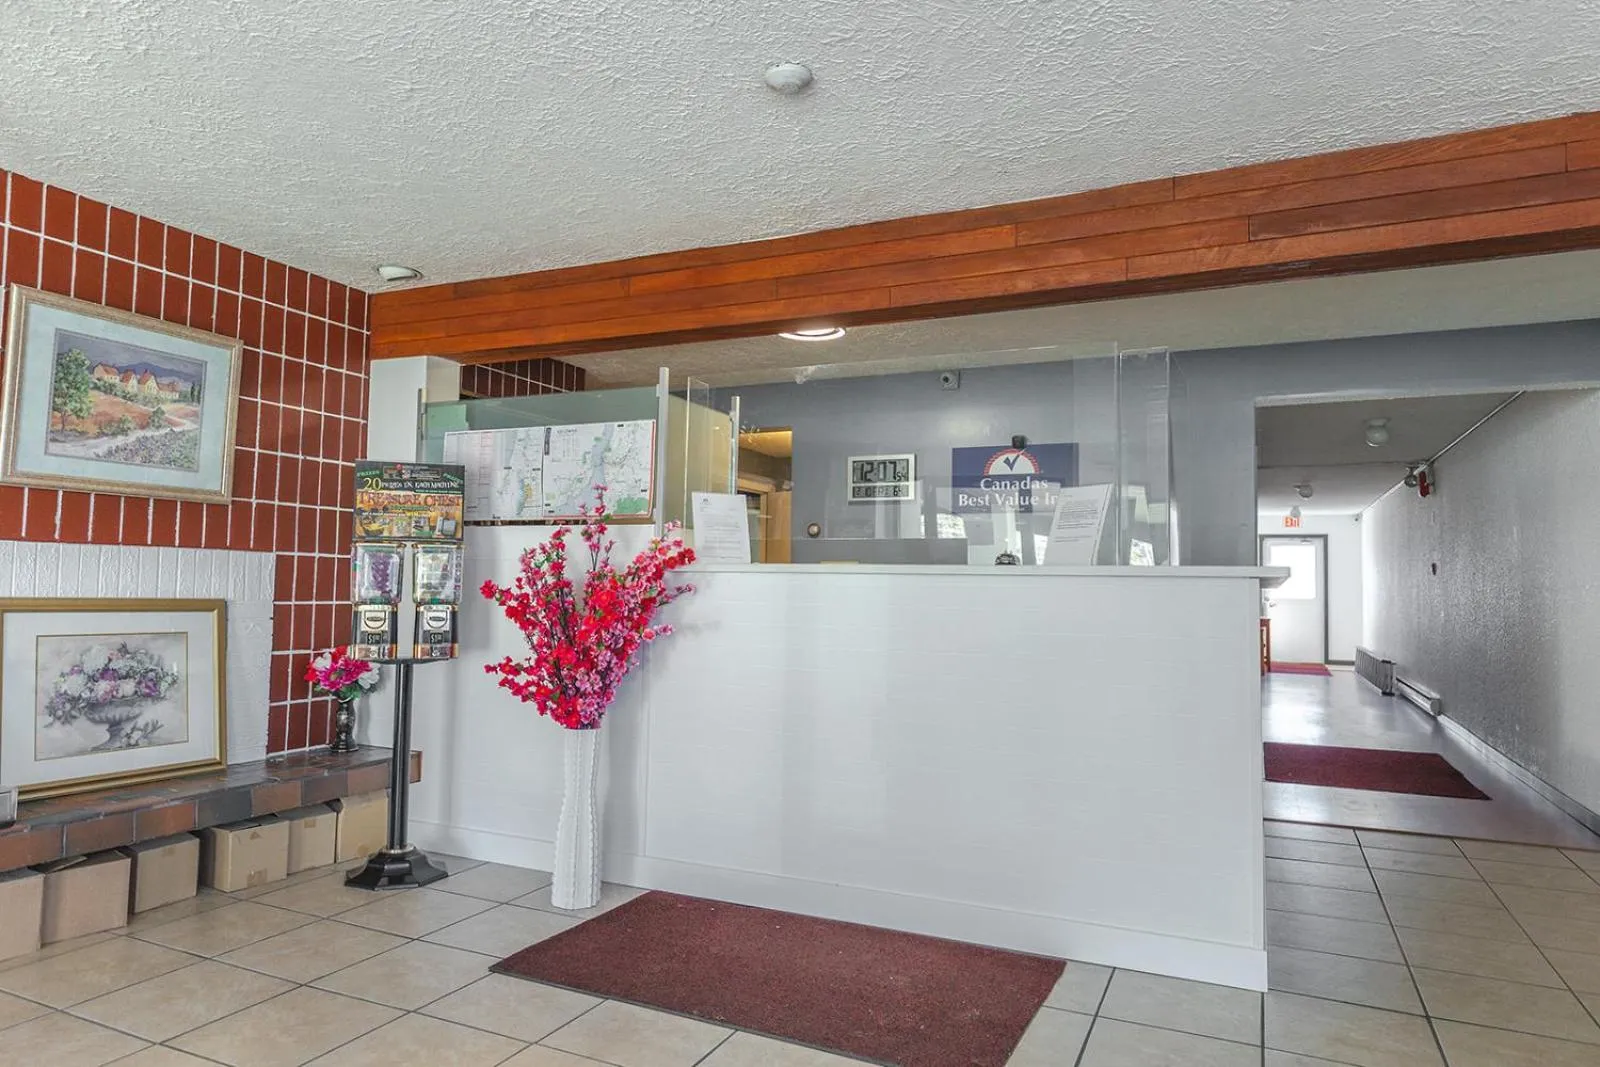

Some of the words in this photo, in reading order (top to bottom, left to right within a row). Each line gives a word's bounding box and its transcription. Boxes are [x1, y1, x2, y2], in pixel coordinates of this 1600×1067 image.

[363, 477, 382, 491] 20
[980, 475, 1048, 491] Canadas
[959, 493, 990, 507] Best
[995, 491, 1040, 506] Value
